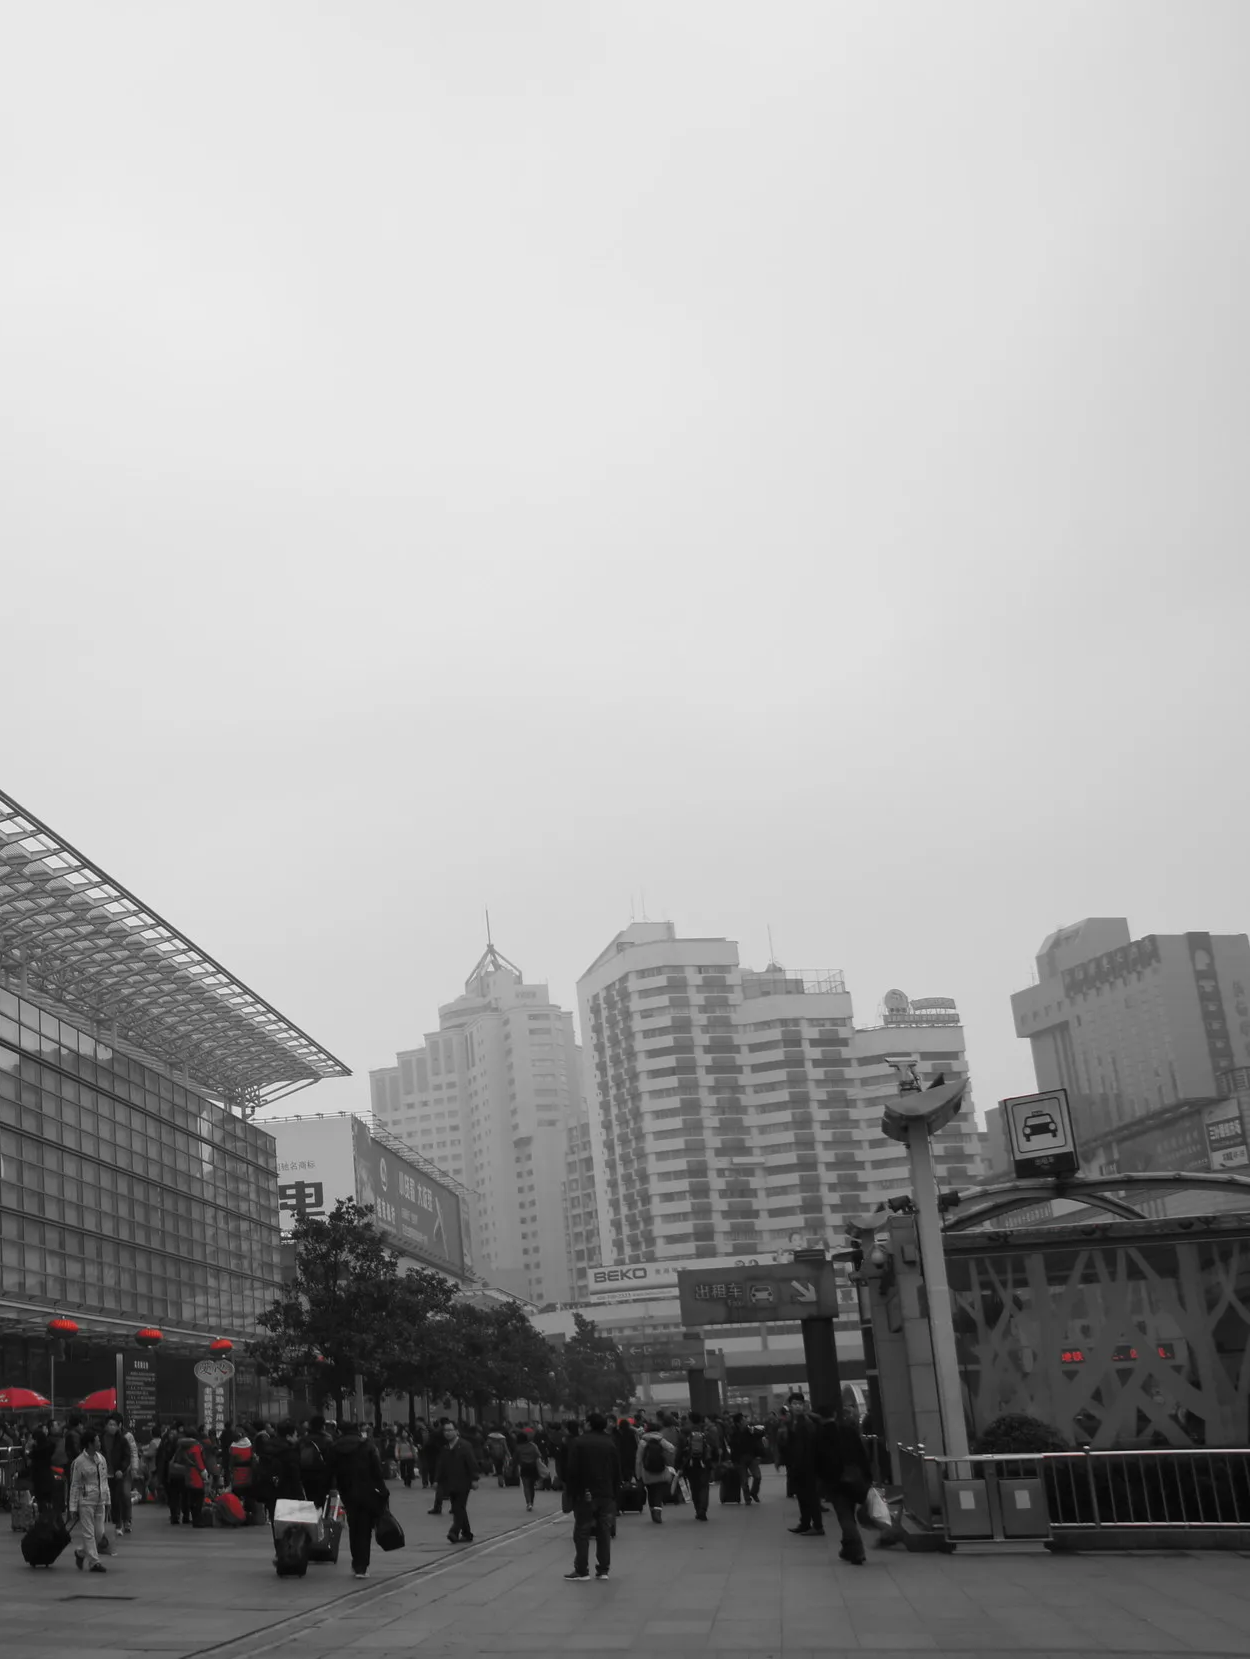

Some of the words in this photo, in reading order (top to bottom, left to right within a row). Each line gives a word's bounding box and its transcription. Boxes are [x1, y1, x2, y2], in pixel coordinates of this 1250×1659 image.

[594, 1267, 648, 1283] BEKO
[695, 1283, 743, 1299] 出租车
